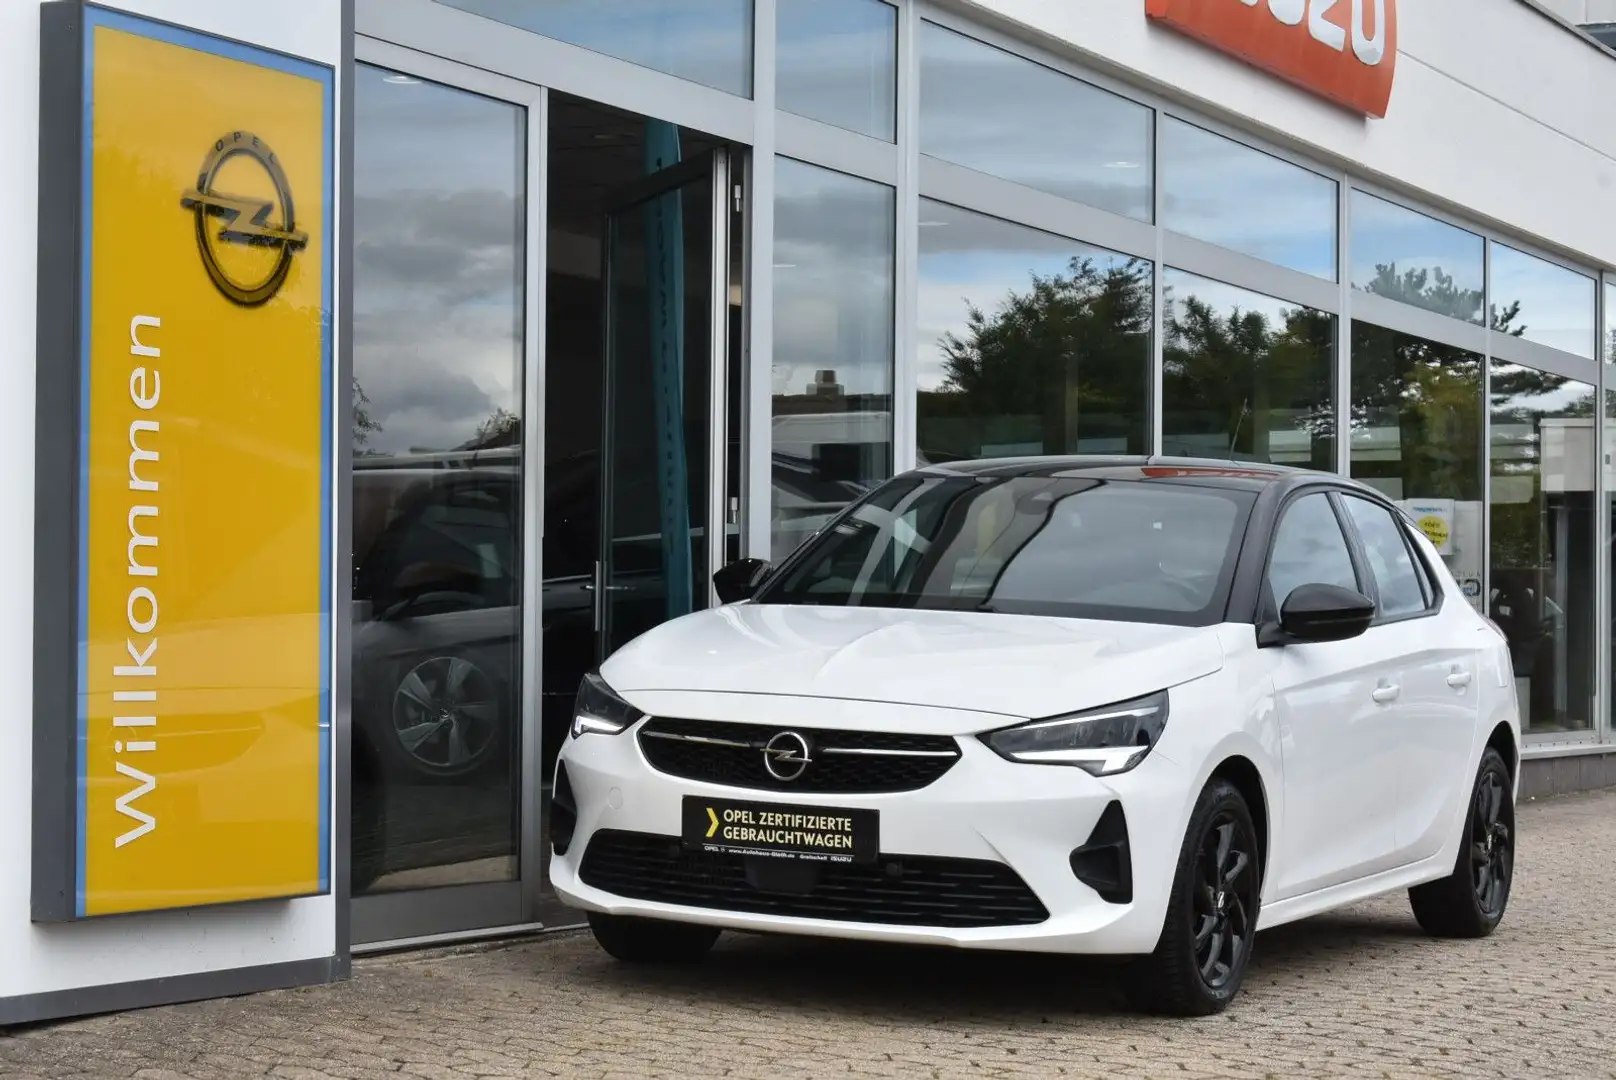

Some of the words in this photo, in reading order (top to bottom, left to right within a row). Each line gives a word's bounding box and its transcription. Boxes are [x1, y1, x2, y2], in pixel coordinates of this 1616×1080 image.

[216, 131, 278, 164] OPEL
[113, 314, 161, 848] Willkommen
[723, 809, 756, 824] OPEL
[759, 812, 852, 831] ZERTIFIZIERTE
[723, 827, 852, 848] GEBRAUCHTWAGEN
